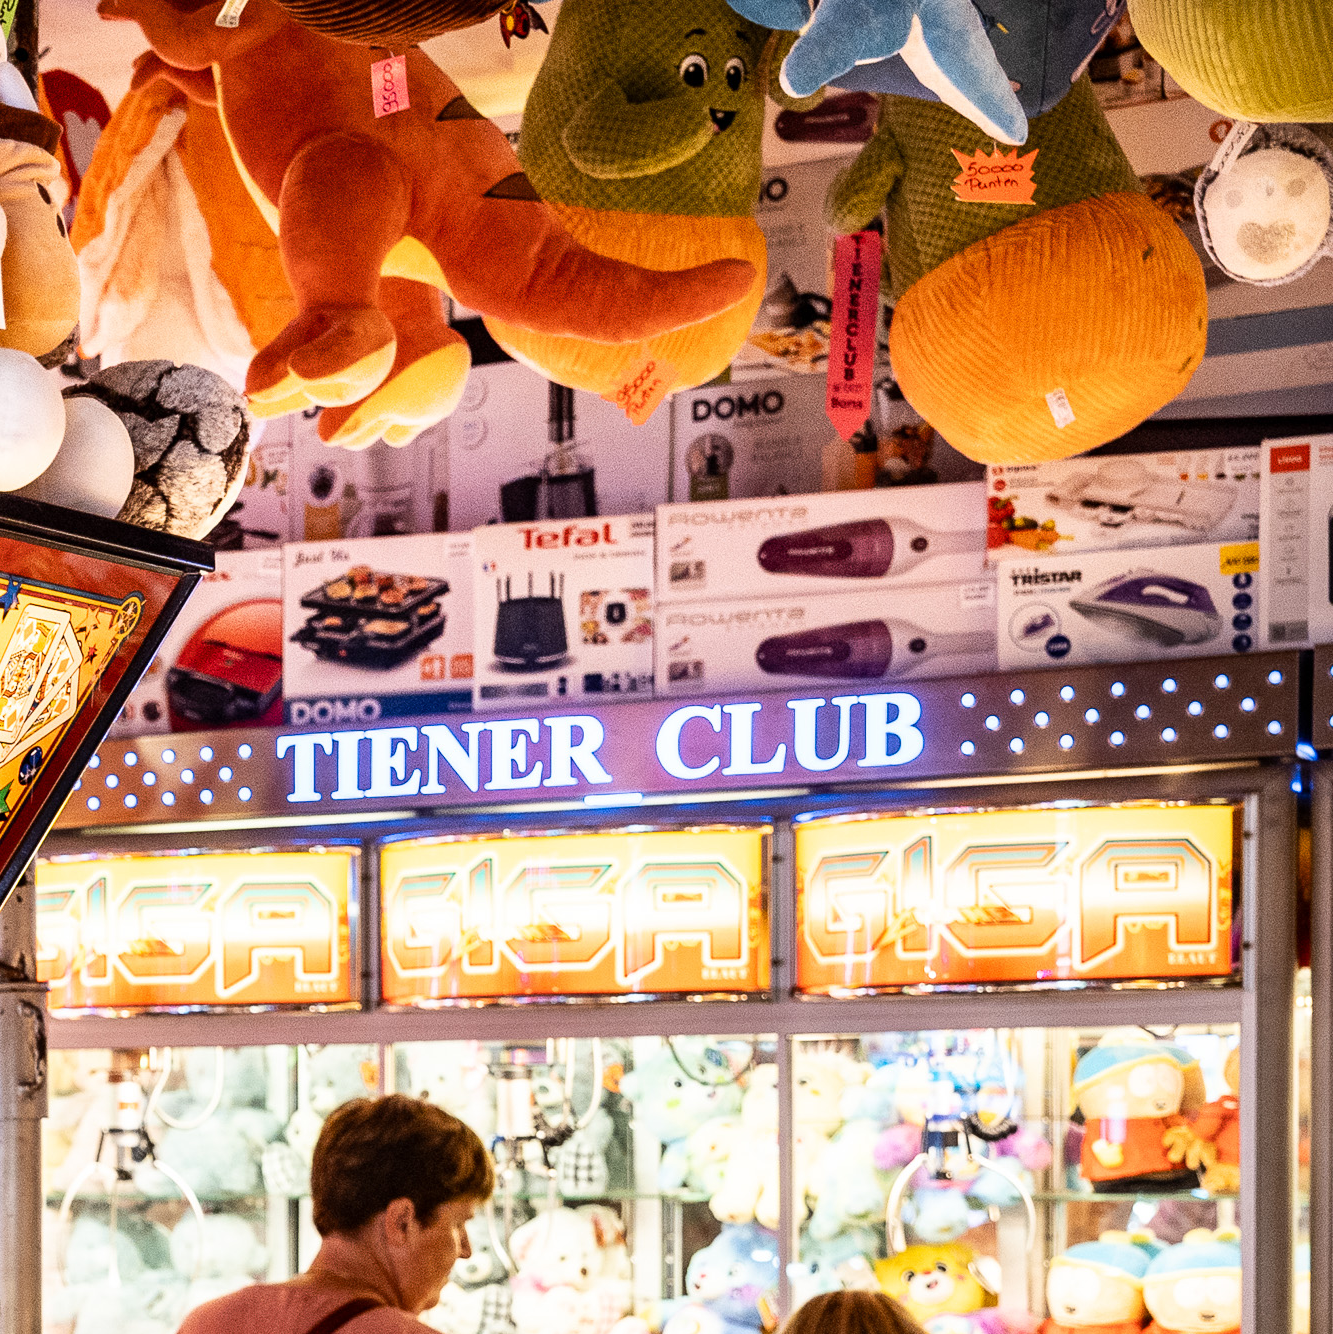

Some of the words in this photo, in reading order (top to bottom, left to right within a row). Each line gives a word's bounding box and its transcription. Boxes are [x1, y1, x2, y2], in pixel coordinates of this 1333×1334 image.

[692, 390, 784, 422] DOMO
[517, 522, 618, 550] Tefal
[1011, 570, 1083, 586] TRISTAR
[290, 697, 382, 727] DOMO
[276, 714, 613, 803] TIENER
[655, 691, 925, 780] CLUB
[803, 835, 1214, 970] GIGA
[387, 857, 746, 986] GIGA
